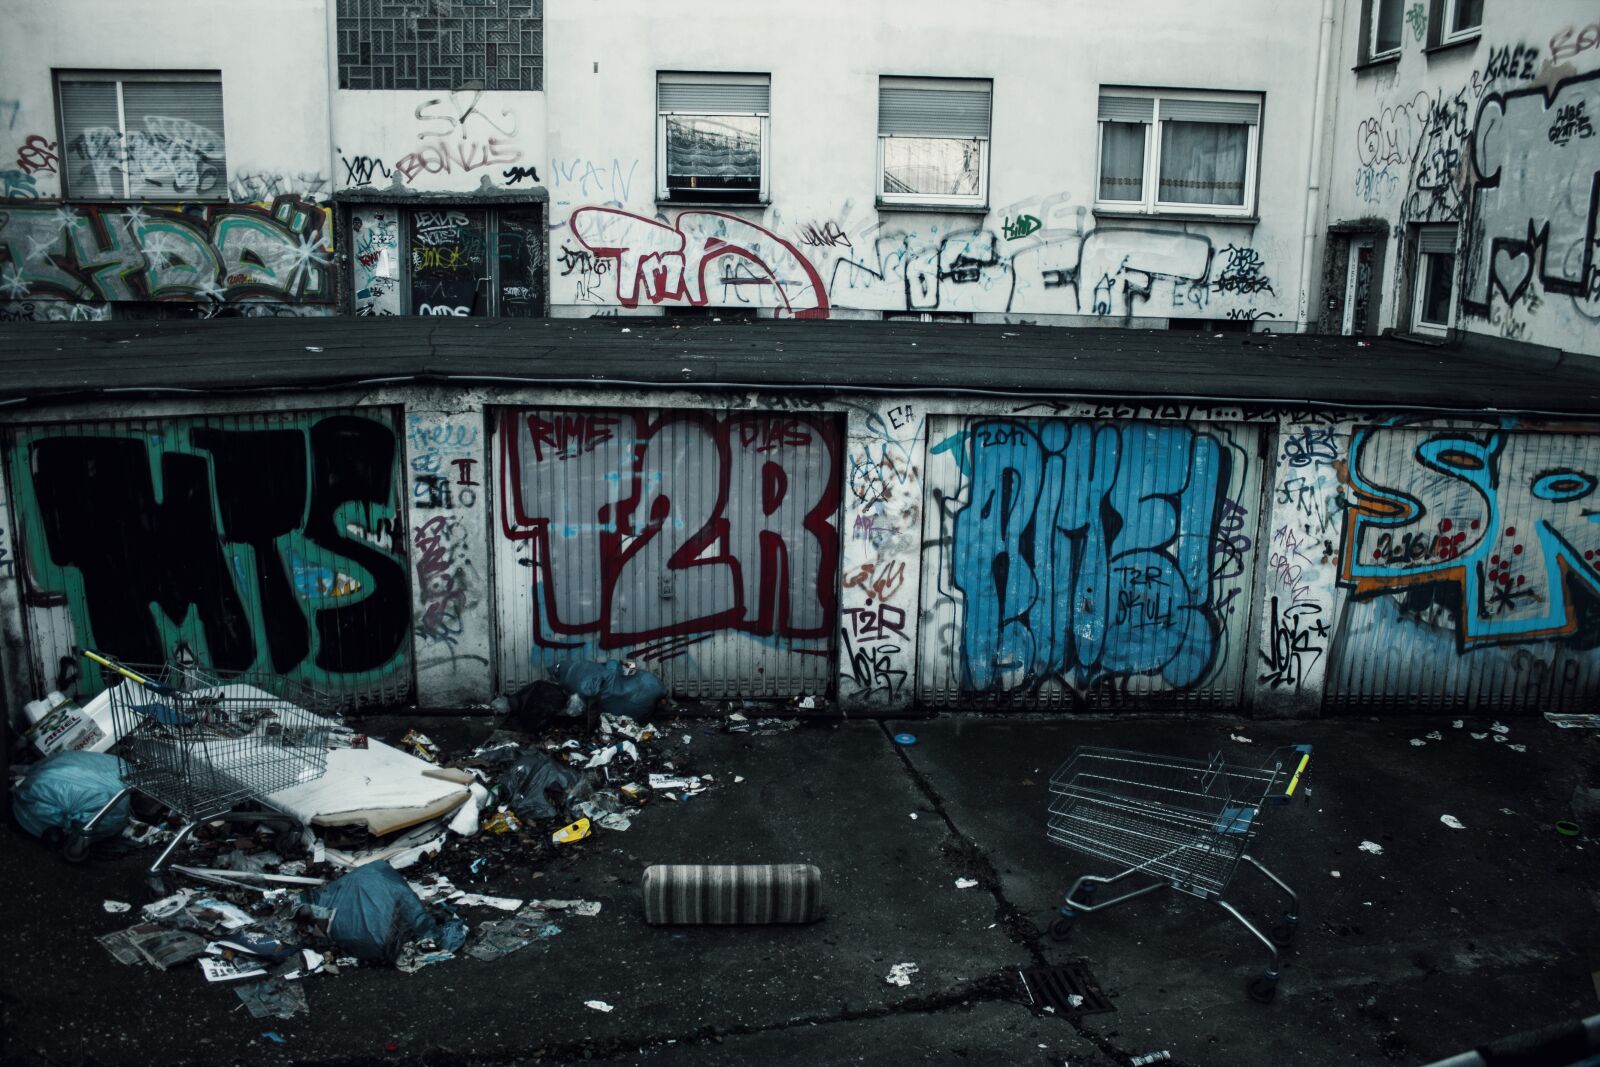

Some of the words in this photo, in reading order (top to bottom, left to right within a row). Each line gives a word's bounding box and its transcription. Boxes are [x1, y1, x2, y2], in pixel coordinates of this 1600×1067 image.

[1113, 566, 1170, 590] T2R
[842, 603, 911, 643] T2R
[44, 716, 81, 745] ARIEL
